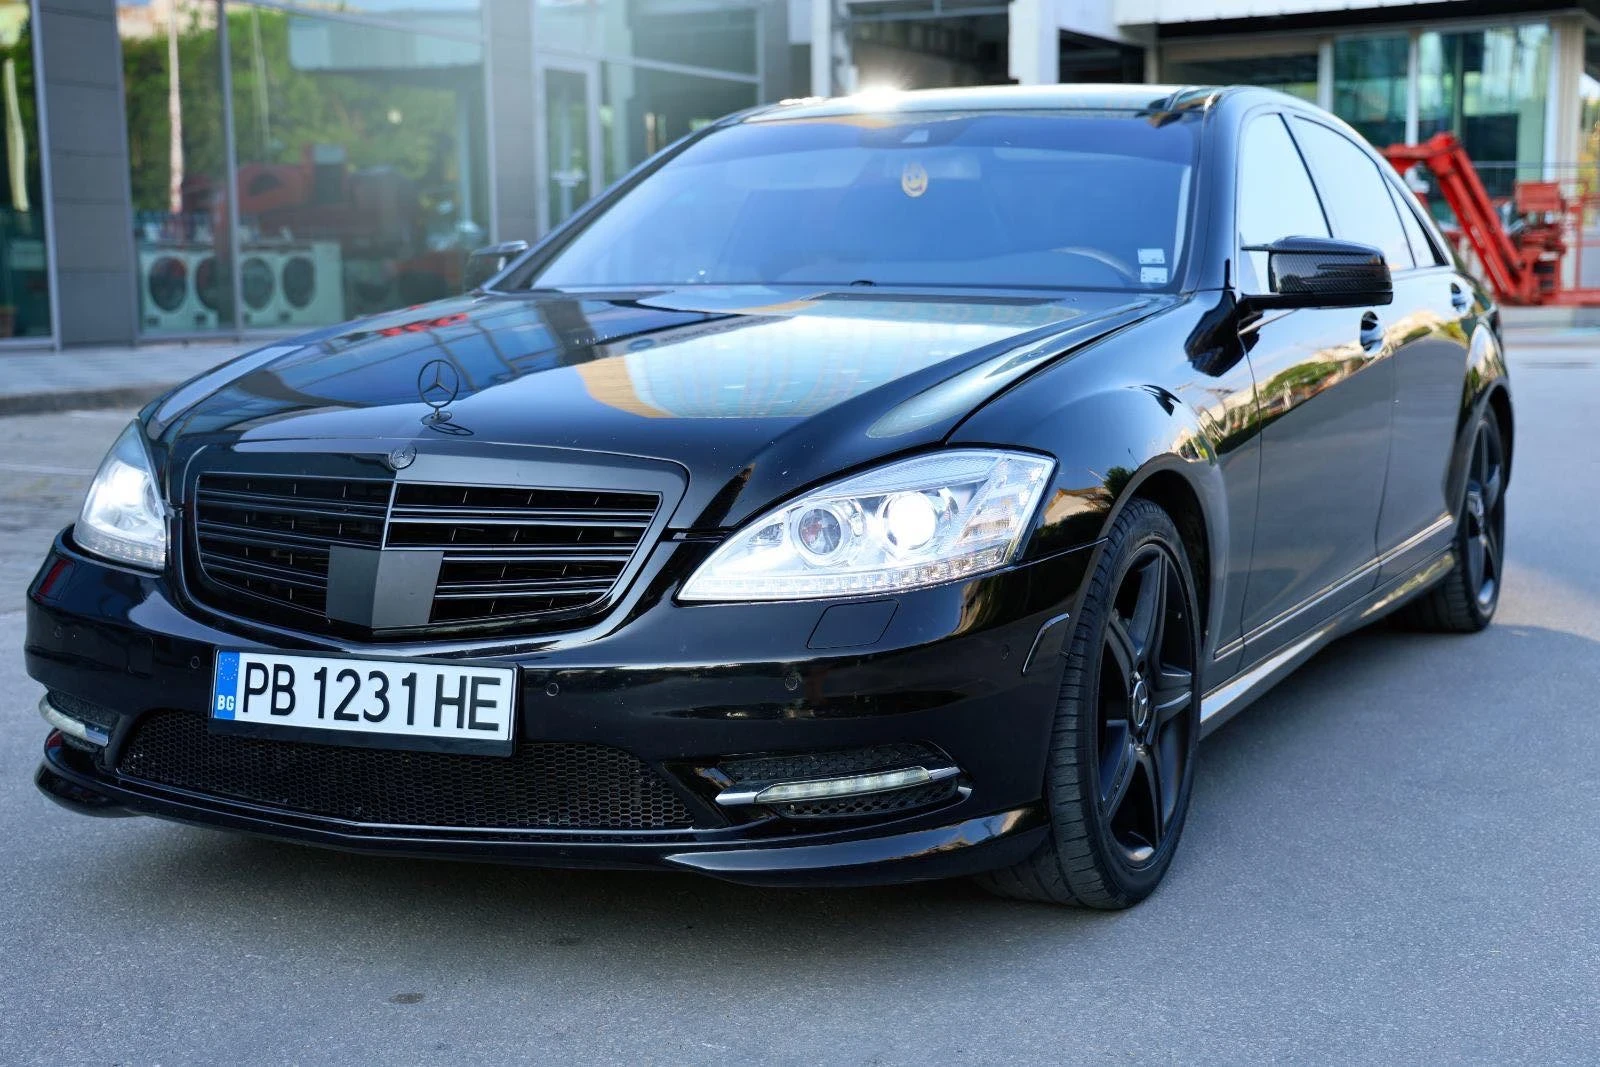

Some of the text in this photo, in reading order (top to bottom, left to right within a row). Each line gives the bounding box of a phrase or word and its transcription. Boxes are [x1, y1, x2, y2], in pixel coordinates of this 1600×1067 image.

[217, 694, 235, 711] BG
[242, 661, 502, 732] PB 1231 HE
